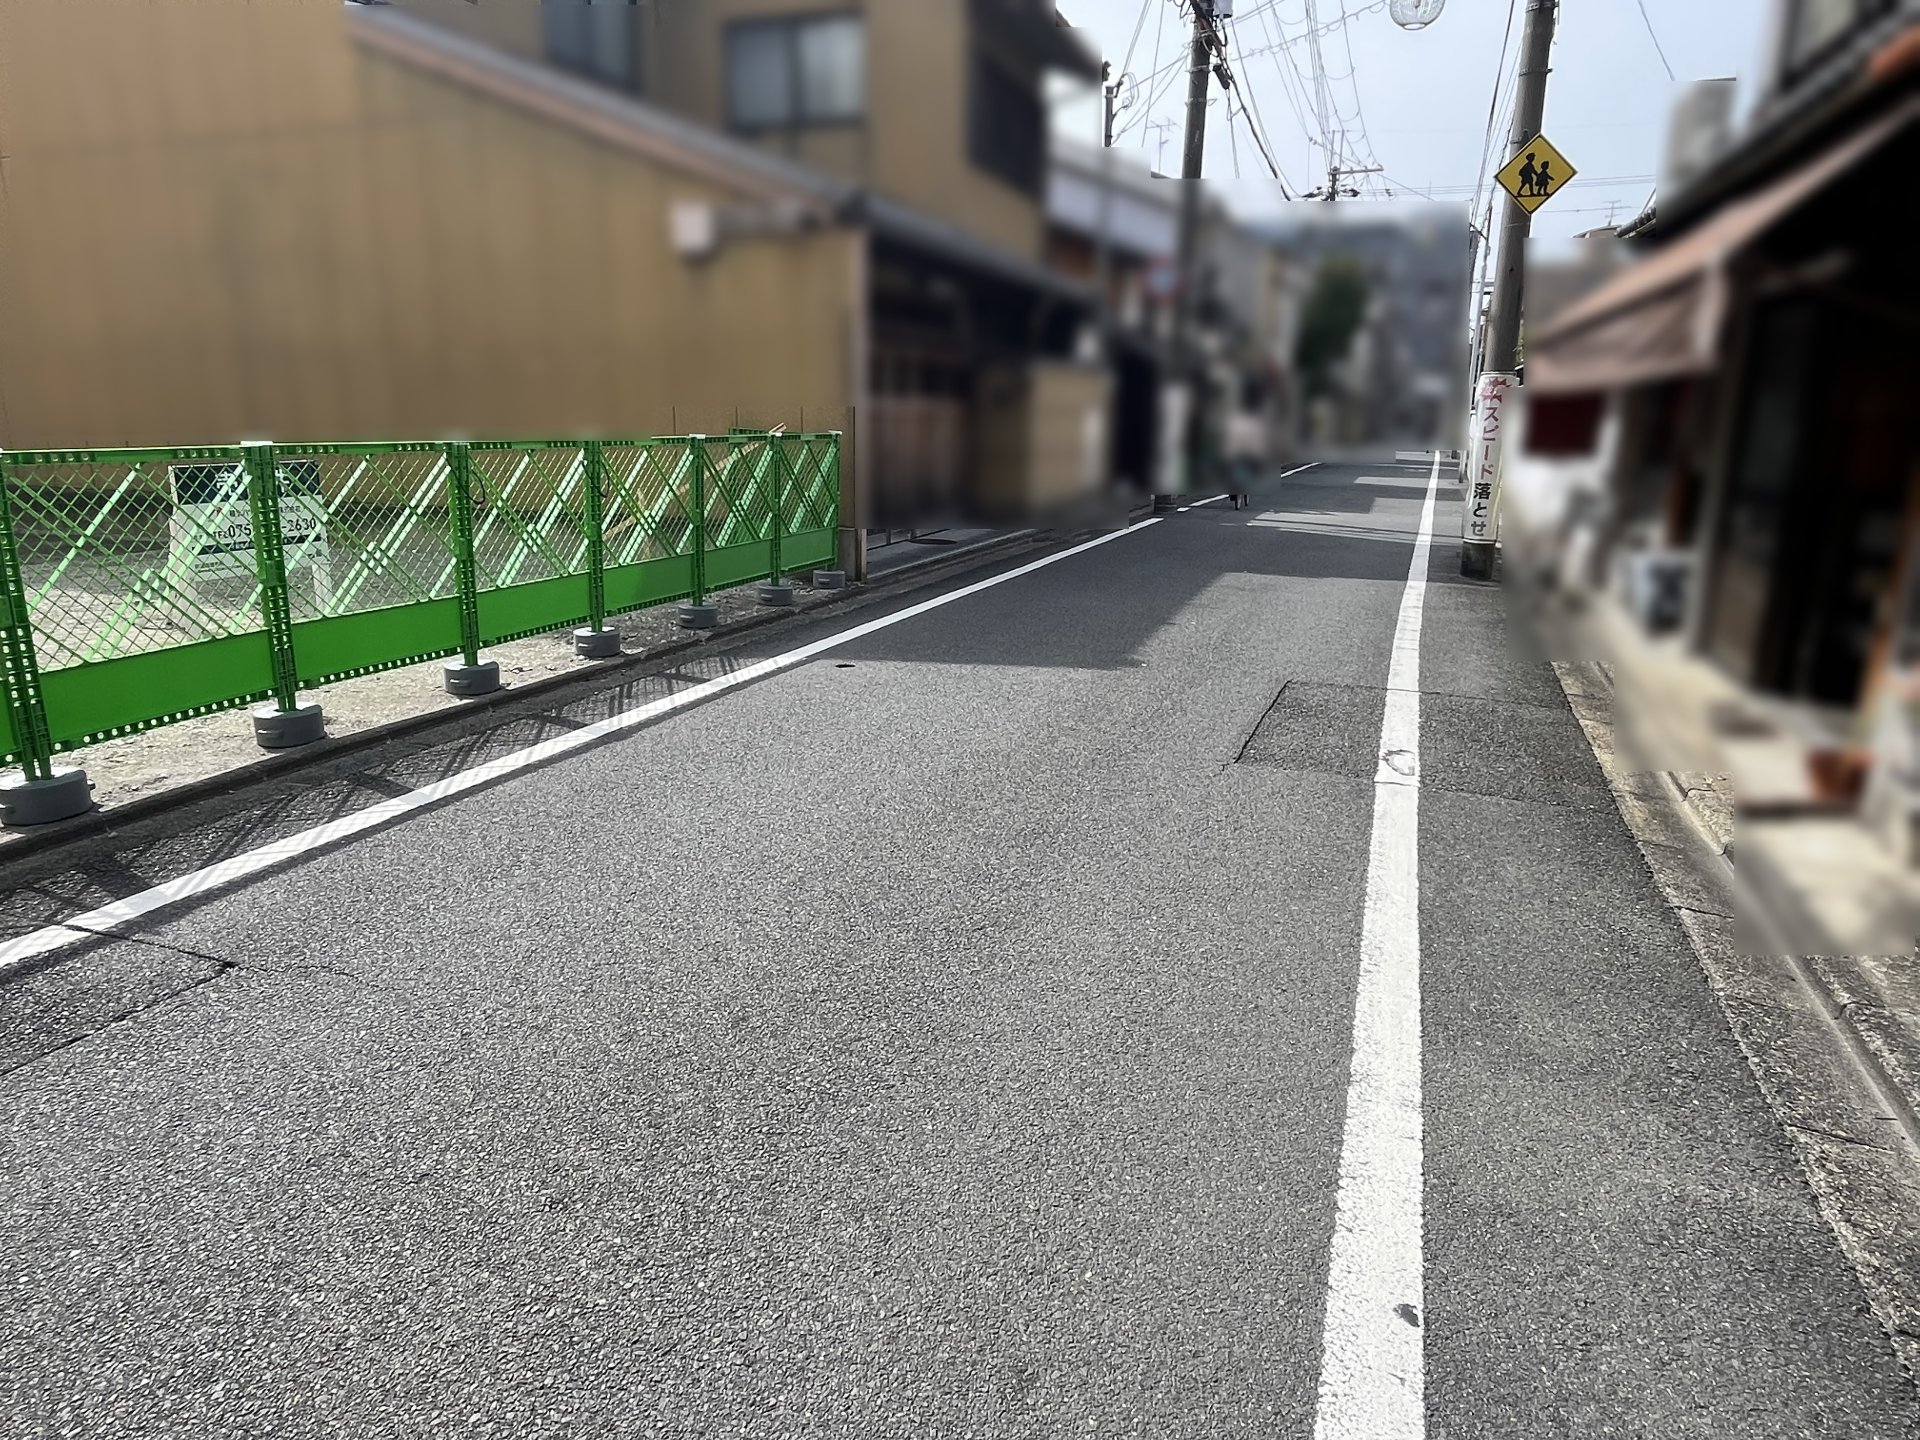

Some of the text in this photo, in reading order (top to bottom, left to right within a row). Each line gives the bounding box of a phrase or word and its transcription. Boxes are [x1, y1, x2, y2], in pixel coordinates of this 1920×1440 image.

[1471, 406, 1499, 537] スピード落とせ
